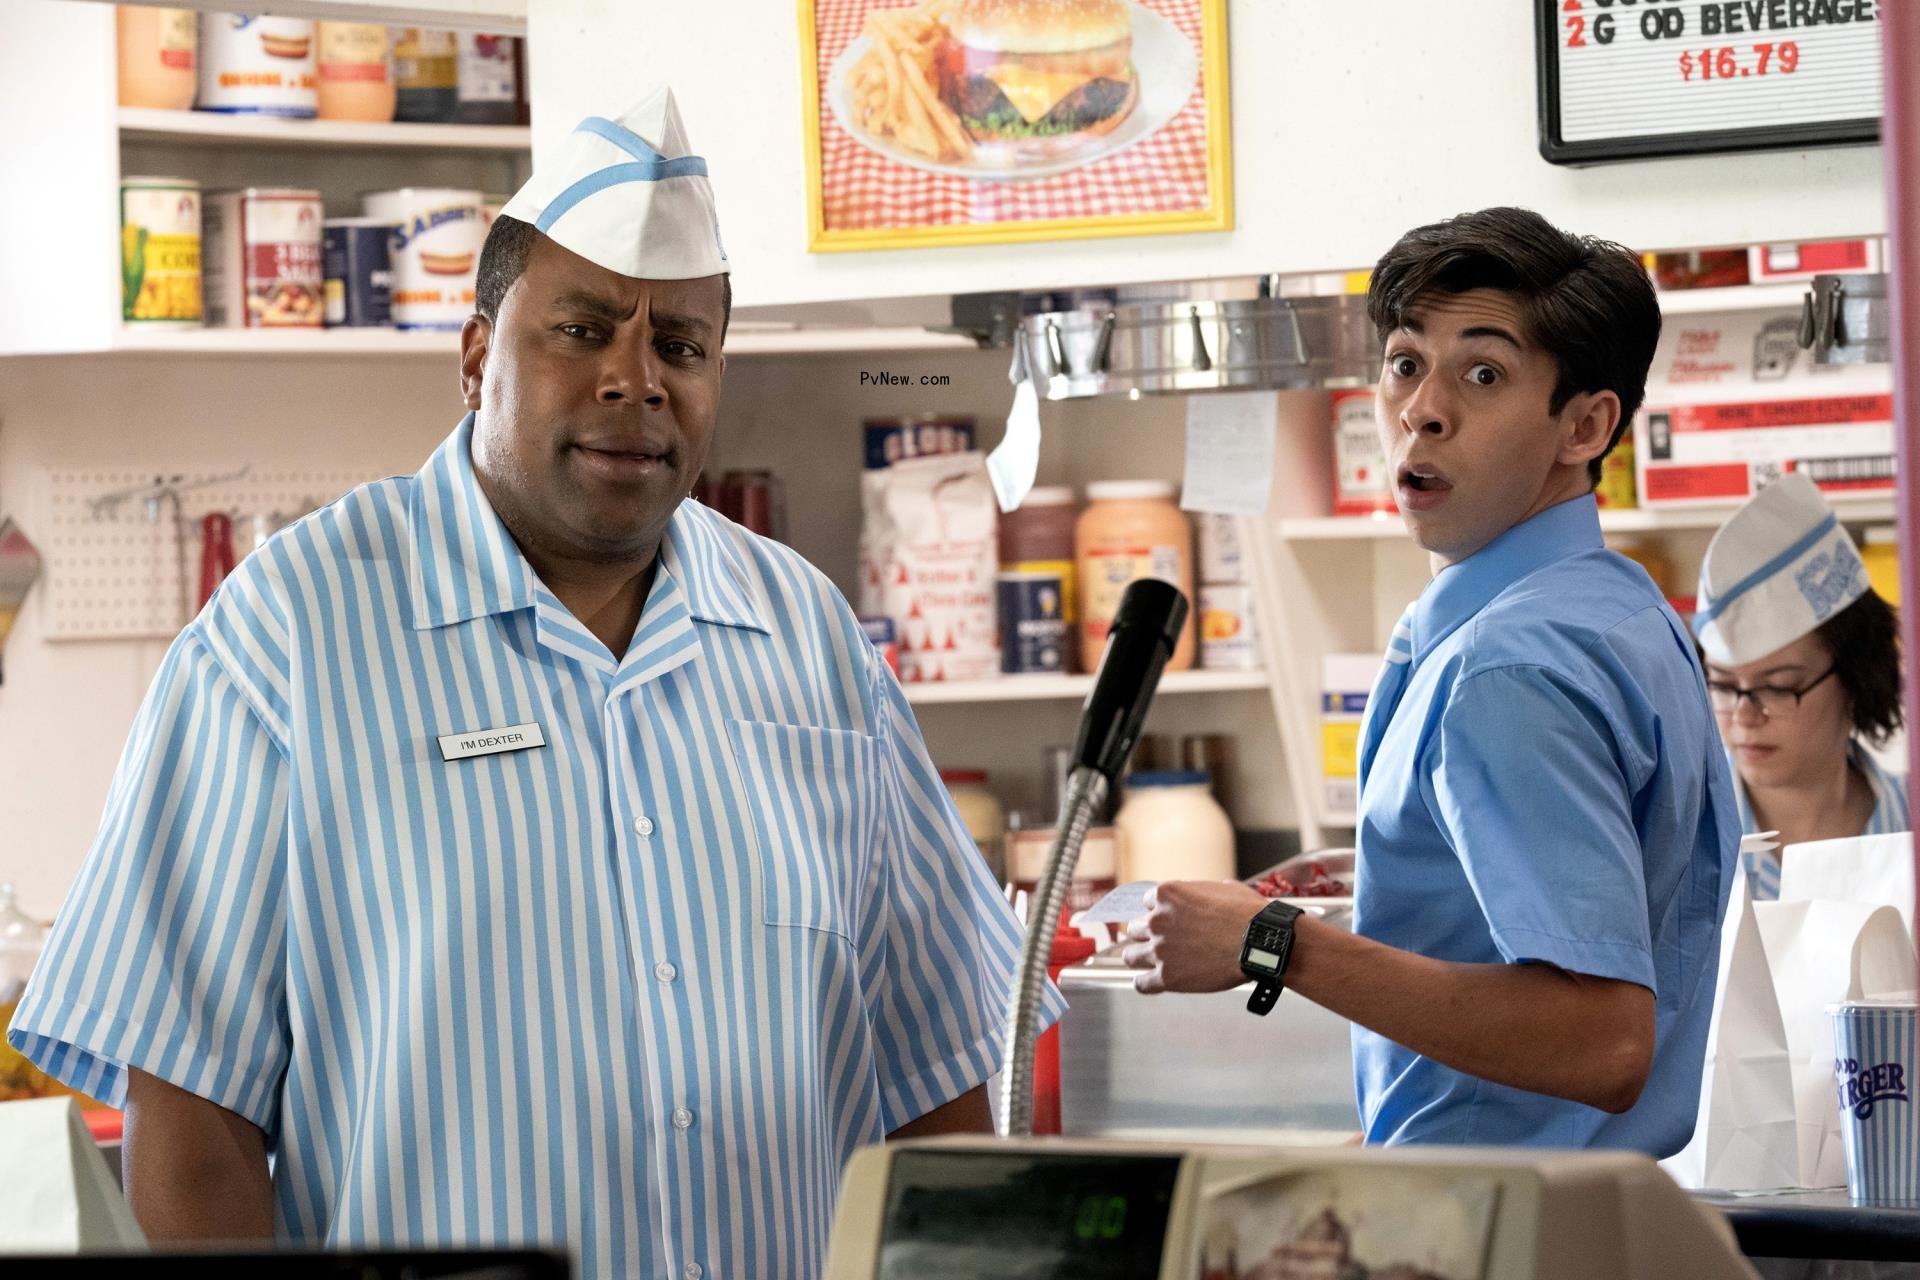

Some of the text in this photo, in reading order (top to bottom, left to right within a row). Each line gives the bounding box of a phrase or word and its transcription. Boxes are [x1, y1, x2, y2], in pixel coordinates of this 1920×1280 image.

[1566, 15, 1586, 48] 2
[1701, 0, 1881, 36] BEVERAGE
[1680, 41, 1799, 81] $16.79
[460, 733, 525, 751] I'M DEXTER
